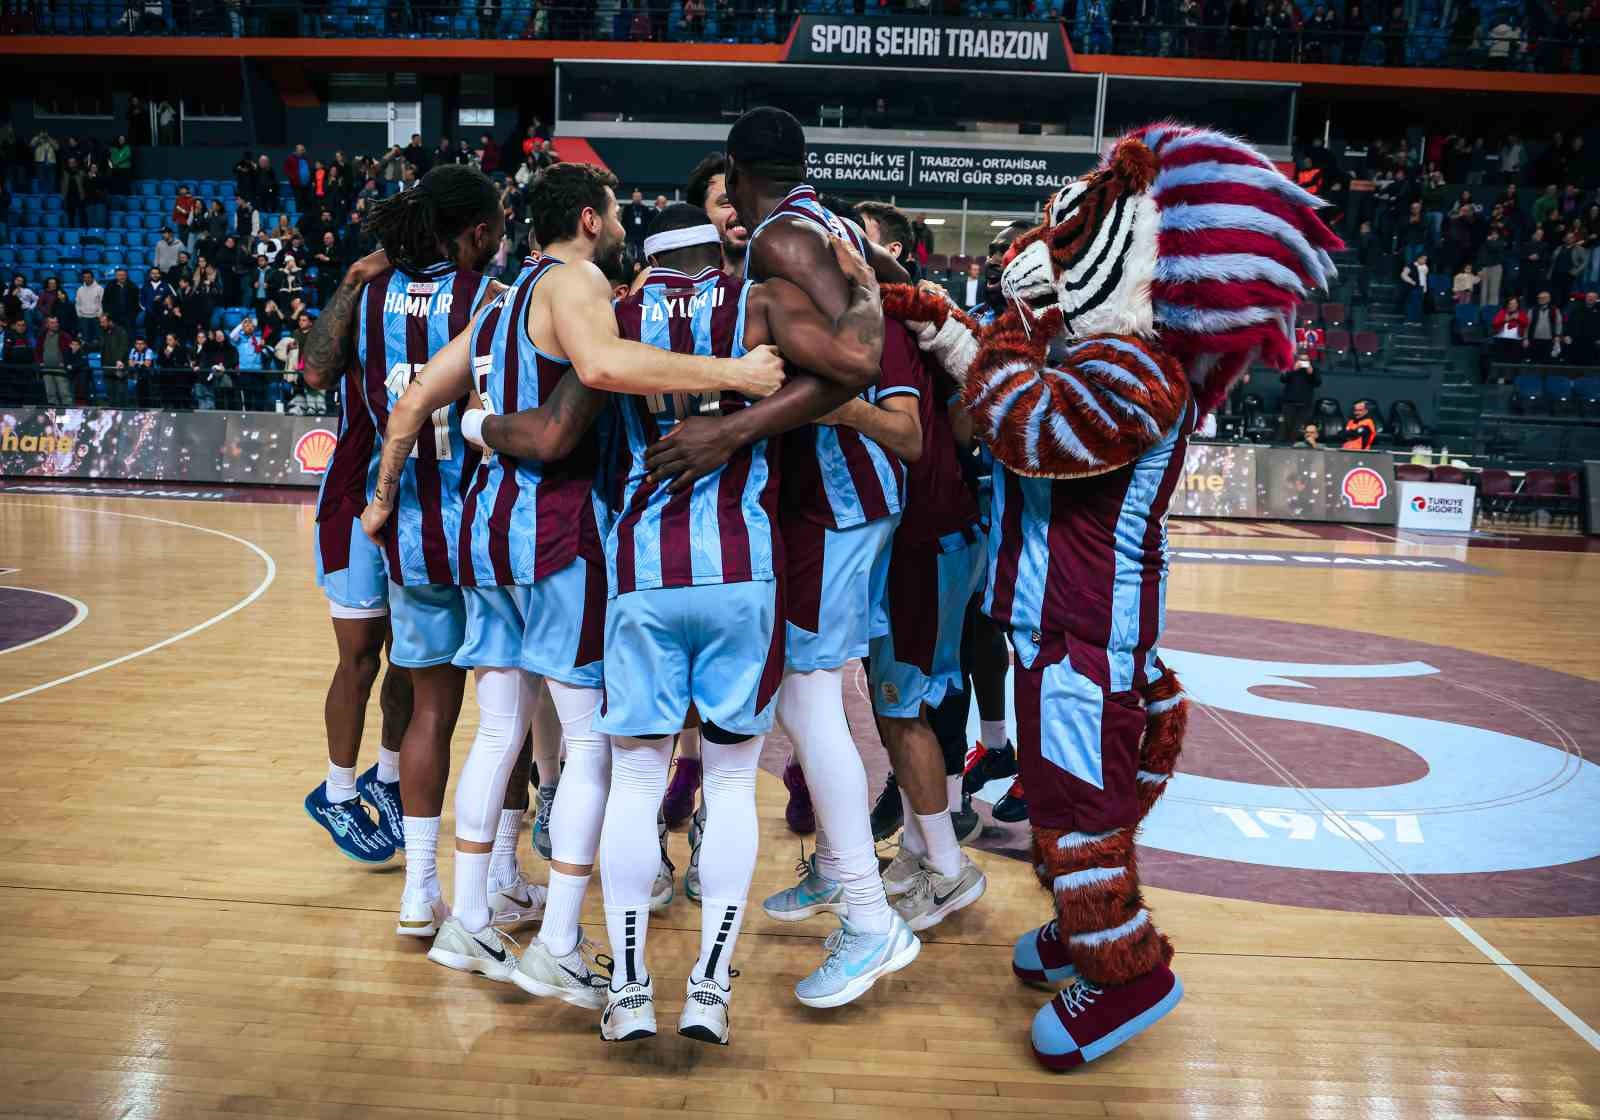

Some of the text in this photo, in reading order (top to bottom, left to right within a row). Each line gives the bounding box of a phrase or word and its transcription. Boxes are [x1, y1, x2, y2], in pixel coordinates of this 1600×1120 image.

[811, 25, 871, 54] SPOR
[945, 28, 1049, 60] TRABZON
[824, 151, 885, 168] GENÇLİK
[887, 154, 905, 167] VE
[920, 156, 974, 168] TRABZON
[982, 157, 1047, 170] ORTAHİSAR
[834, 168, 905, 182] BAKANLIĞI
[919, 168, 960, 184] HAYRİ
[962, 169, 992, 185] GÜR
[994, 172, 1033, 187] SPOR
